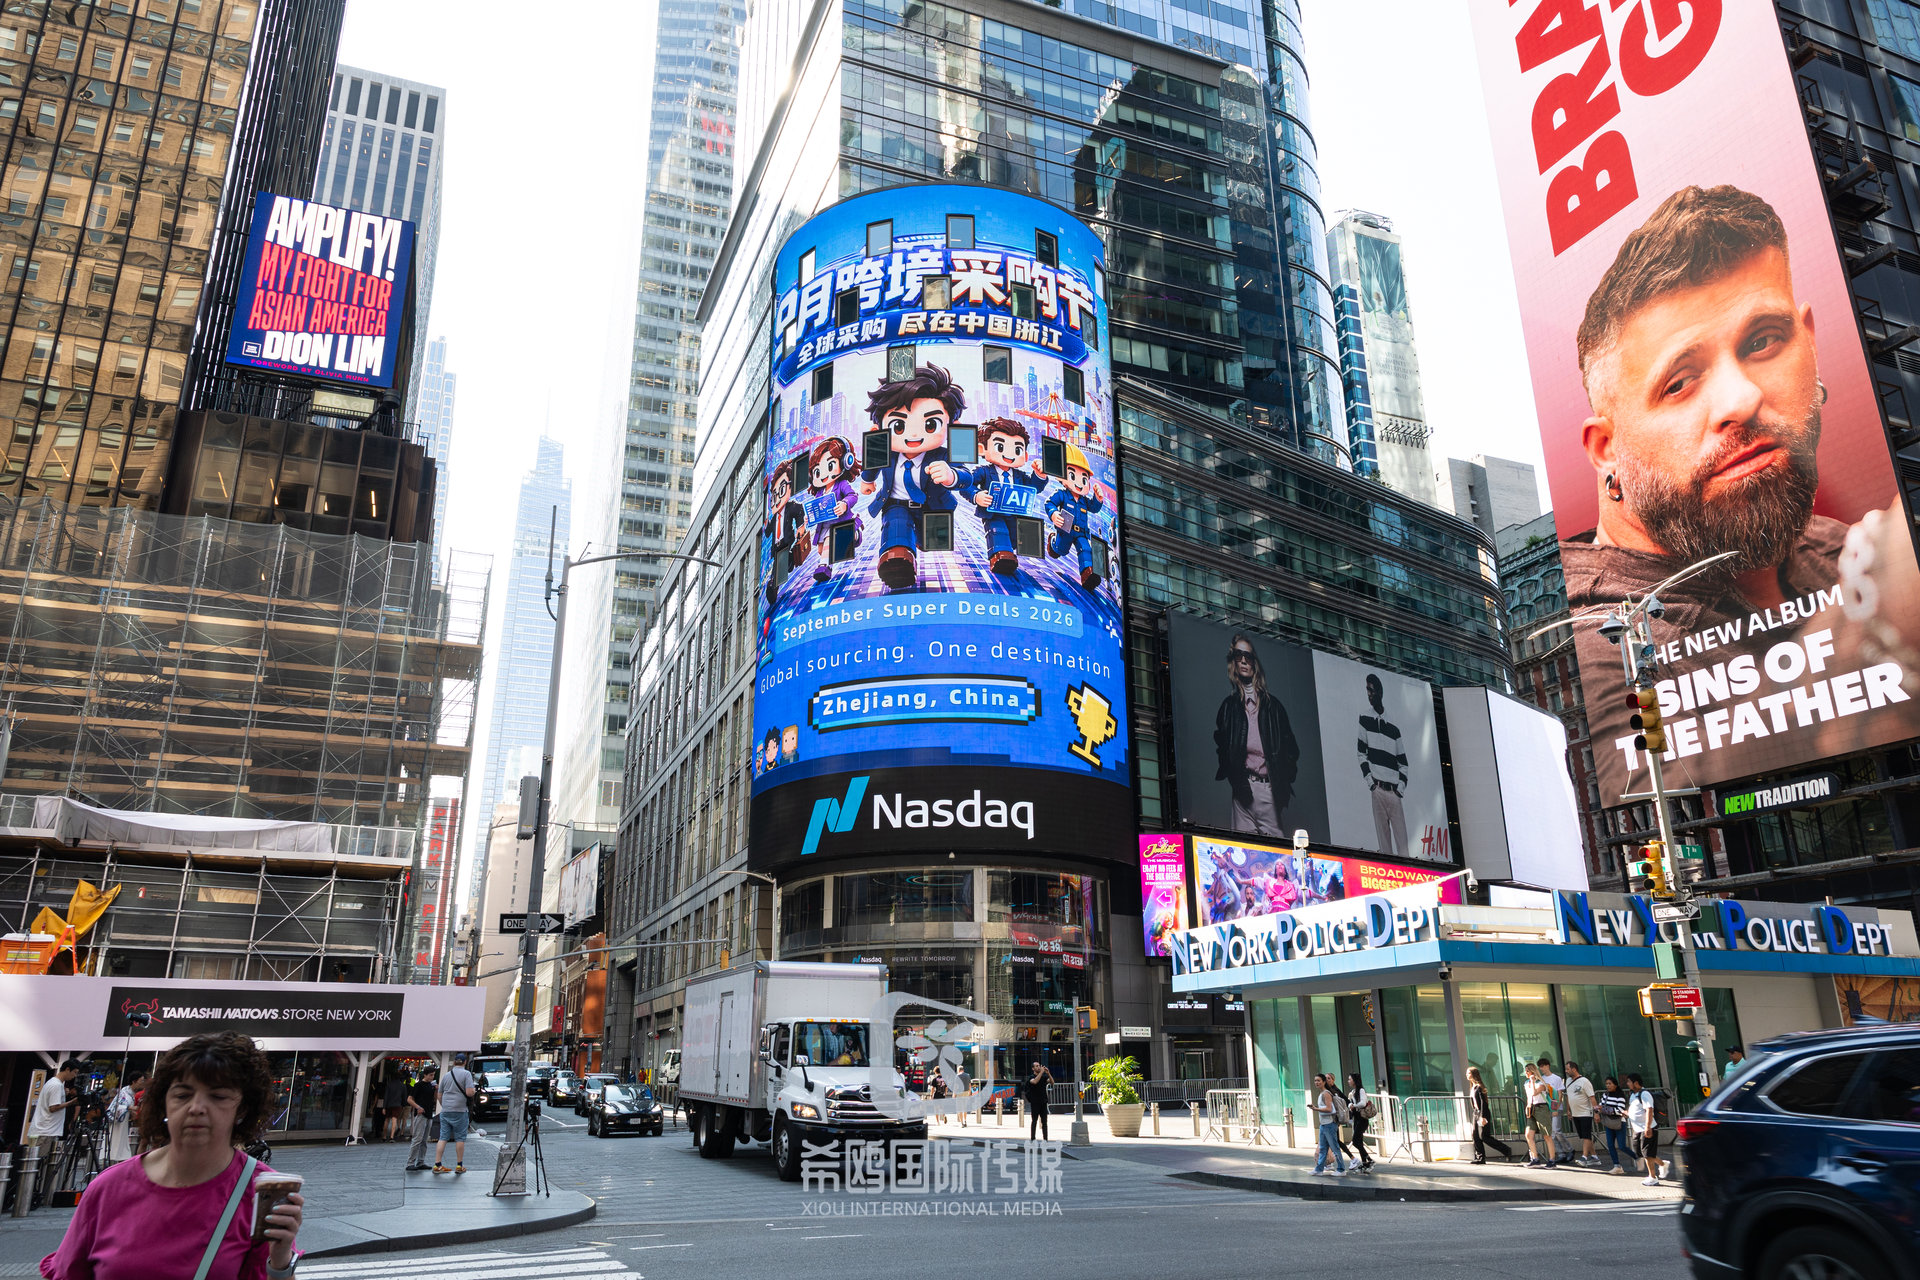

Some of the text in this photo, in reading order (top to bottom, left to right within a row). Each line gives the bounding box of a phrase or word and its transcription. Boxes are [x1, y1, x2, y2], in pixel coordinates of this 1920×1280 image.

[1508, 0, 1639, 257] BRA
[265, 196, 402, 281] AMPLIFY!
[256, 241, 392, 311] MY FIGHT FOR
[248, 289, 387, 336] ASIAN AMERICA
[262, 331, 385, 376] DION LIM
[797, 311, 1064, 369] 全球采购 尽在中国浙江
[251, 359, 298, 371] FOREWORD
[315, 369, 343, 378] OLIVIA
[1006, 490, 1028, 507] AI
[783, 600, 1073, 642] September Super Deals 2026
[1653, 584, 1844, 666] HE NEW ALBUM
[760, 641, 1111, 694] Global sourcing. One destination
[1653, 628, 1835, 719] SINS OF
[823, 688, 1019, 716] Zhejiang, China
[1703, 662, 1911, 751] FATHER
[427, 807, 447, 867] PARK
[873, 790, 1035, 840] Nasdaq
[1421, 824, 1448, 860] H&M
[1686, 847, 1690, 856] 7
[1361, 876, 1402, 891] BIGGEST
[416, 904, 435, 966] PARK
[506, 920, 552, 928] ONE AY
[1552, 889, 1893, 956] NEW YO POLICE DEPT
[1656, 906, 1693, 917] ONE WAY
[1171, 896, 1441, 975] NEW YORK POLICE DEPT
[1012, 956, 1035, 964] Nasdaq
[162, 1006, 222, 1020] TAMASHII
[282, 1008, 322, 1021] STORE
[326, 1009, 357, 1020] NEW
[357, 1010, 391, 1021] YORK
[1019, 999, 1039, 1007] Nasdaq
